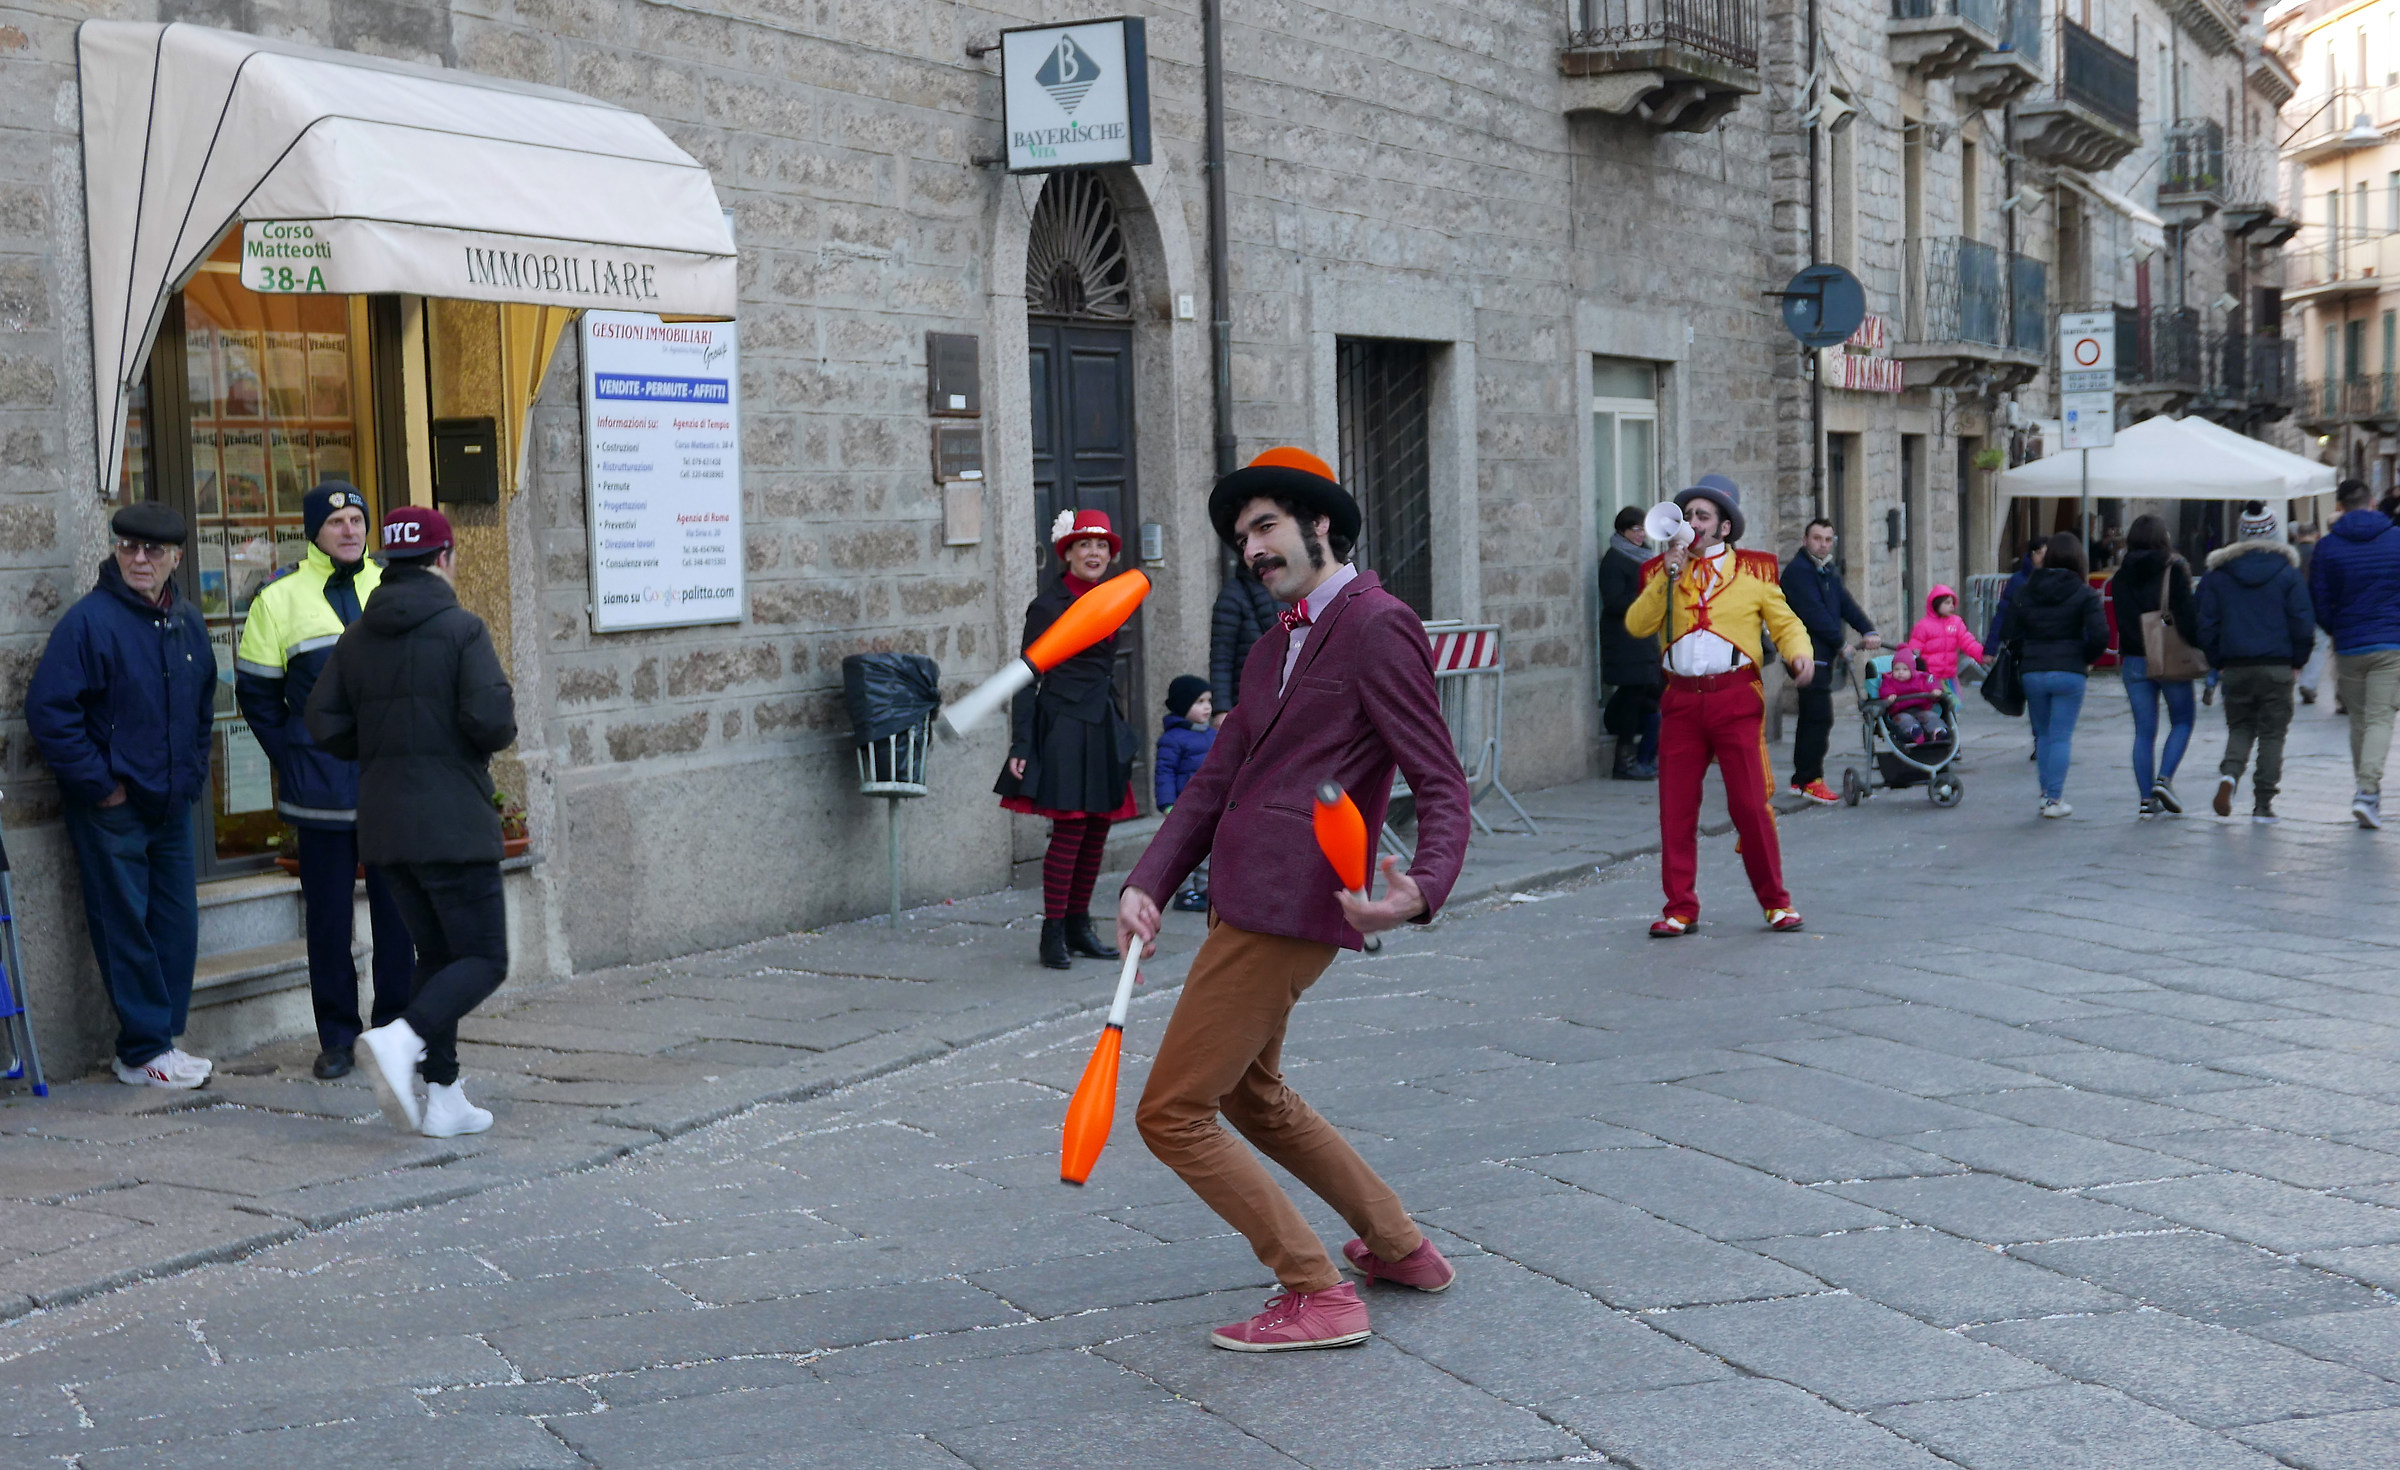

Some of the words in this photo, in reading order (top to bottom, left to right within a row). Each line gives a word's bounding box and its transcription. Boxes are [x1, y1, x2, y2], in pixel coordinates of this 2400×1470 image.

[1013, 121, 1126, 149] BAYERISCHE
[1028, 143, 1057, 159] VITA
[263, 220, 313, 239] Corso
[247, 241, 332, 259] Matteotti
[258, 265, 327, 293] 38-A
[465, 247, 659, 300] IMMOBILIARE
[592, 322, 643, 340] GESTIONI
[645, 327, 713, 345] IMMOBILIARI
[1847, 314, 1885, 349] ANCA
[599, 379, 640, 397] VENDITE
[645, 381, 688, 399] PERMUTE
[693, 383, 726, 400] AFFITTI
[597, 415, 646, 429] Informazioni
[673, 418, 698, 431] Agenzia
[700, 418, 706, 429] di
[223, 432, 262, 448] VENDESI
[602, 441, 640, 452] Costruzioni
[602, 461, 654, 472] Ristrutturazioni
[603, 481, 630, 492] Permute
[603, 500, 647, 513] Progettazioni
[604, 520, 637, 530] Preventivi
[676, 513, 702, 525] Agenzia
[703, 513, 710, 522] di
[711, 513, 730, 522] Roma
[605, 539, 635, 549] Direzione
[636, 537, 655, 549] lavori
[605, 558, 641, 569] Consulenze
[643, 557, 659, 567] varie
[603, 592, 629, 605] siamo
[631, 593, 641, 603] su
[682, 584, 734, 604] palitta.com
